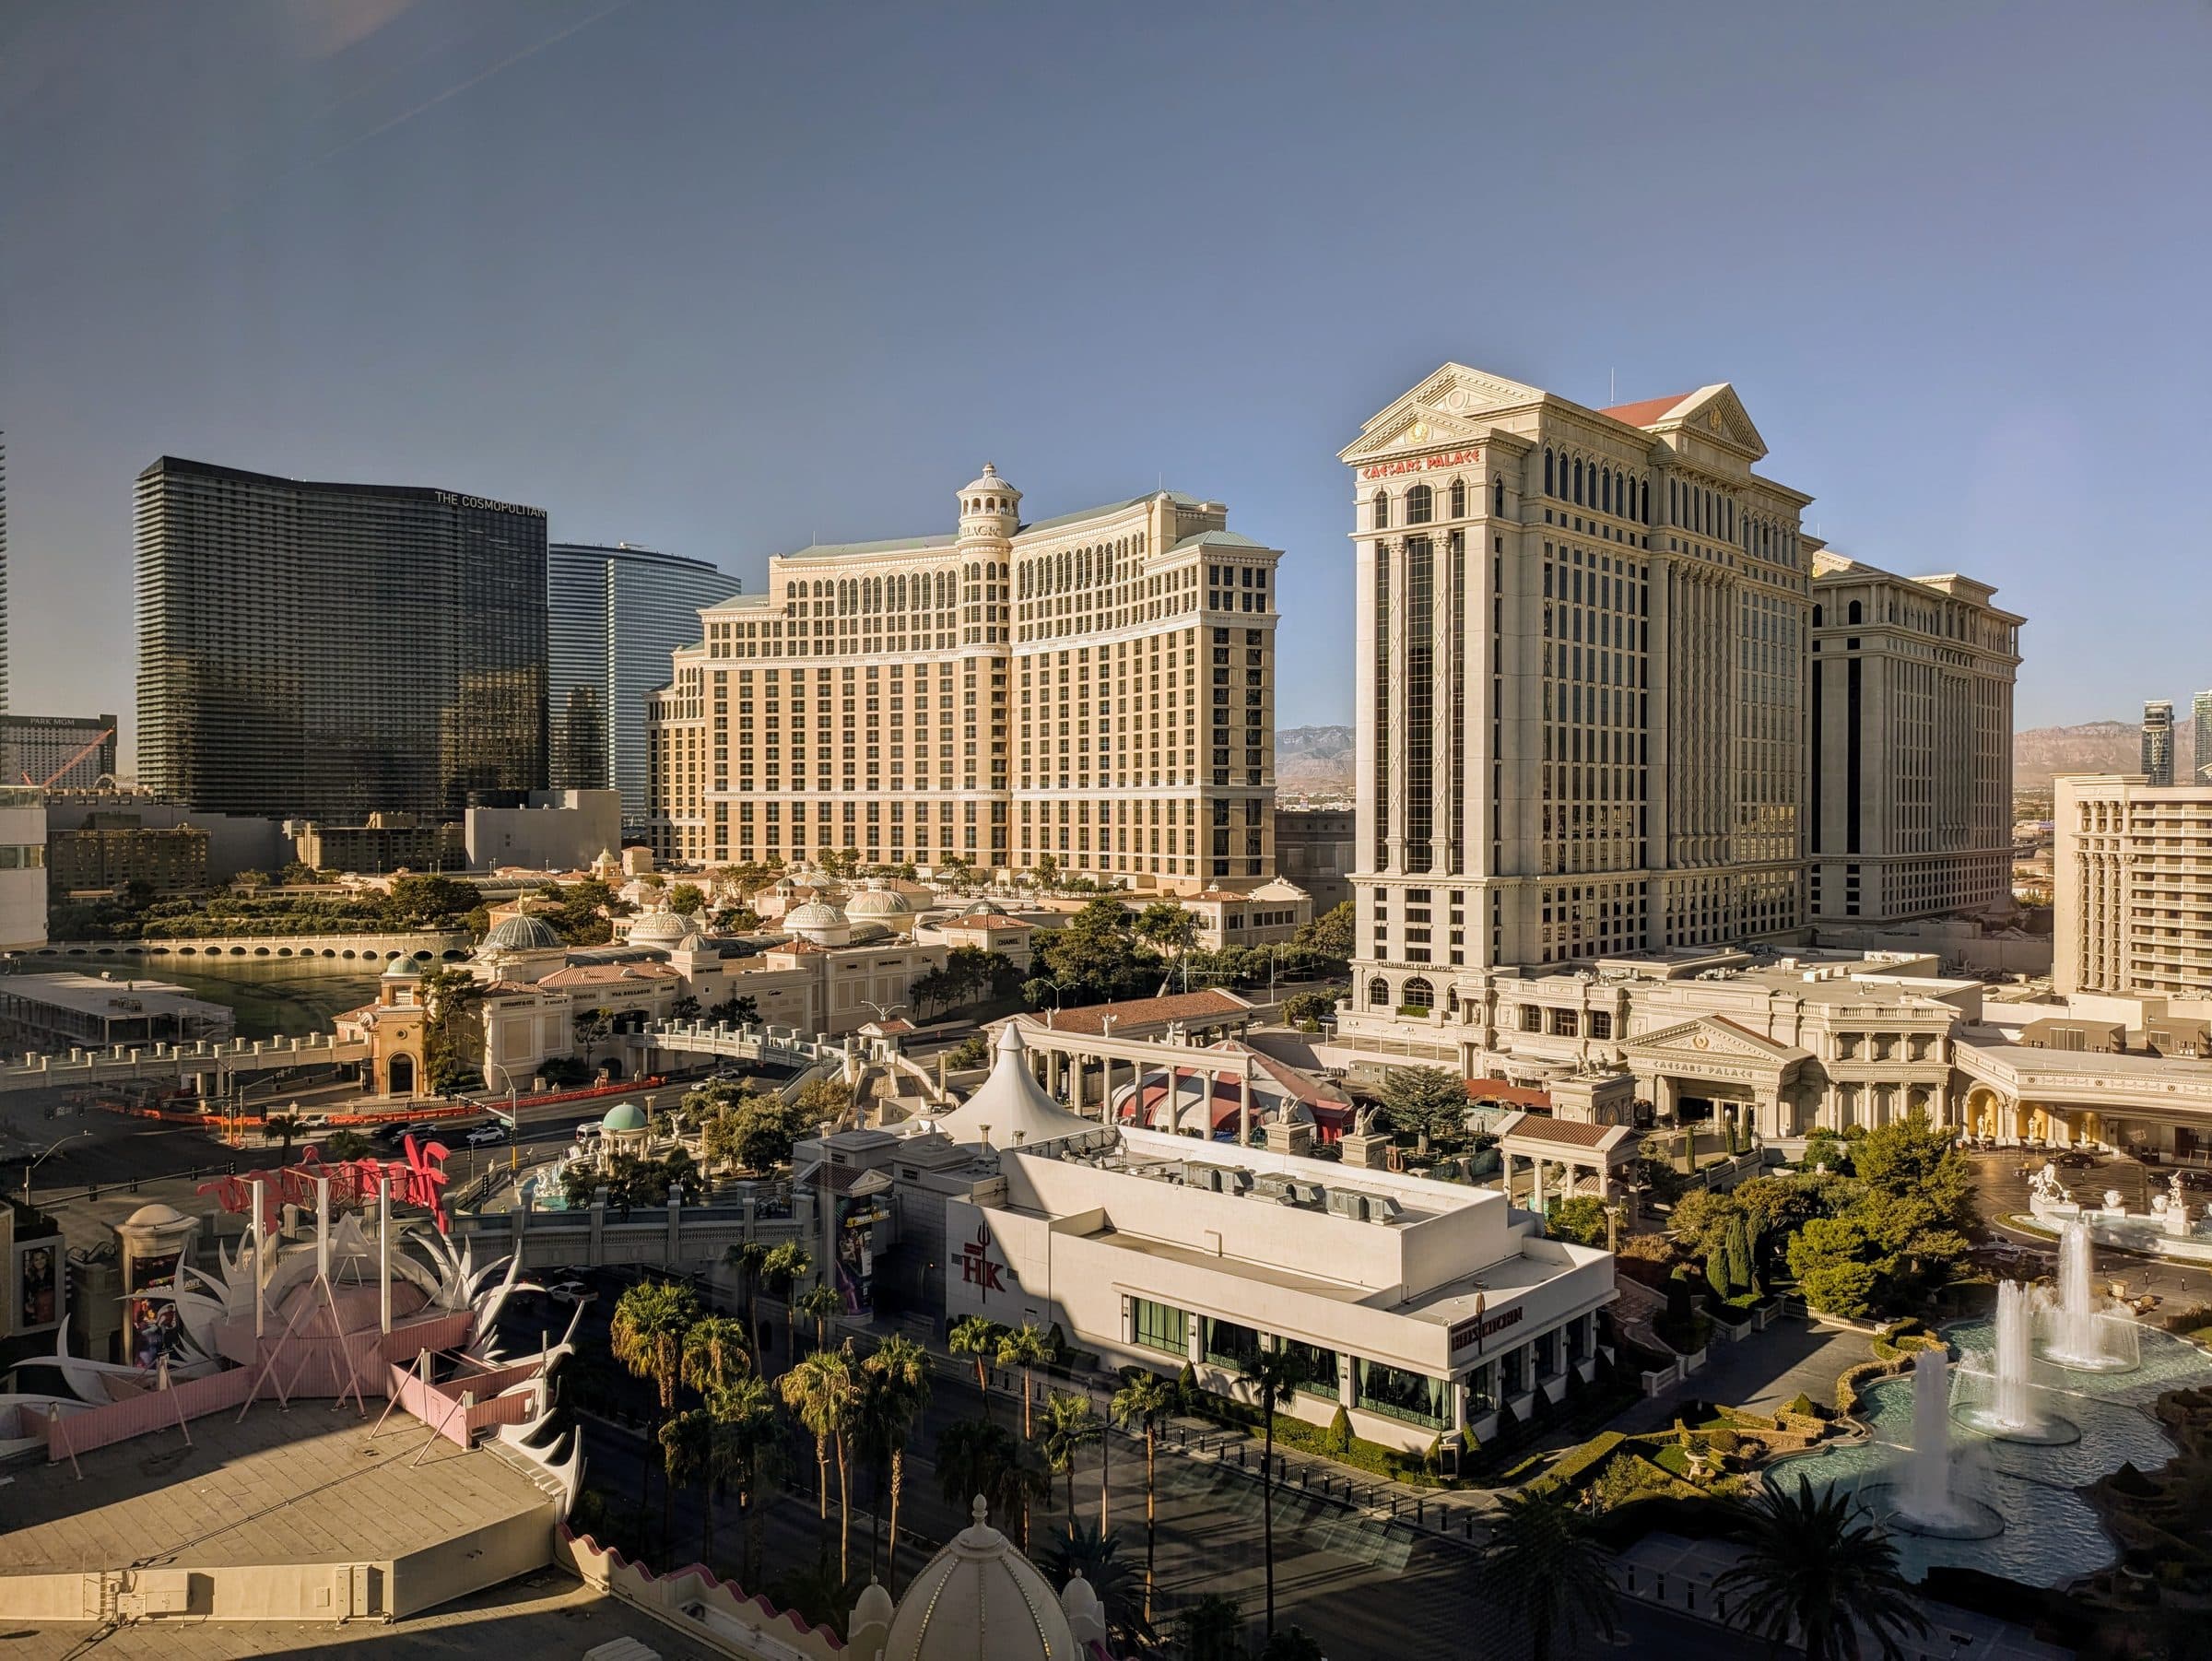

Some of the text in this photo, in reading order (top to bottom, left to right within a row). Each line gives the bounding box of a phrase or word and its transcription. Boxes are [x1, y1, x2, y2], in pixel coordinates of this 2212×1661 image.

[1362, 449, 1479, 479] CAESARS PALACE
[435, 491, 546, 518] THE COSMOPOLITAN
[997, 937, 1018, 946] CHANEL
[1377, 960, 1415, 969] RESTAURANT
[623, 988, 651, 996] BELLAGIO
[1653, 1060, 1752, 1078] CAESARS PALACE
